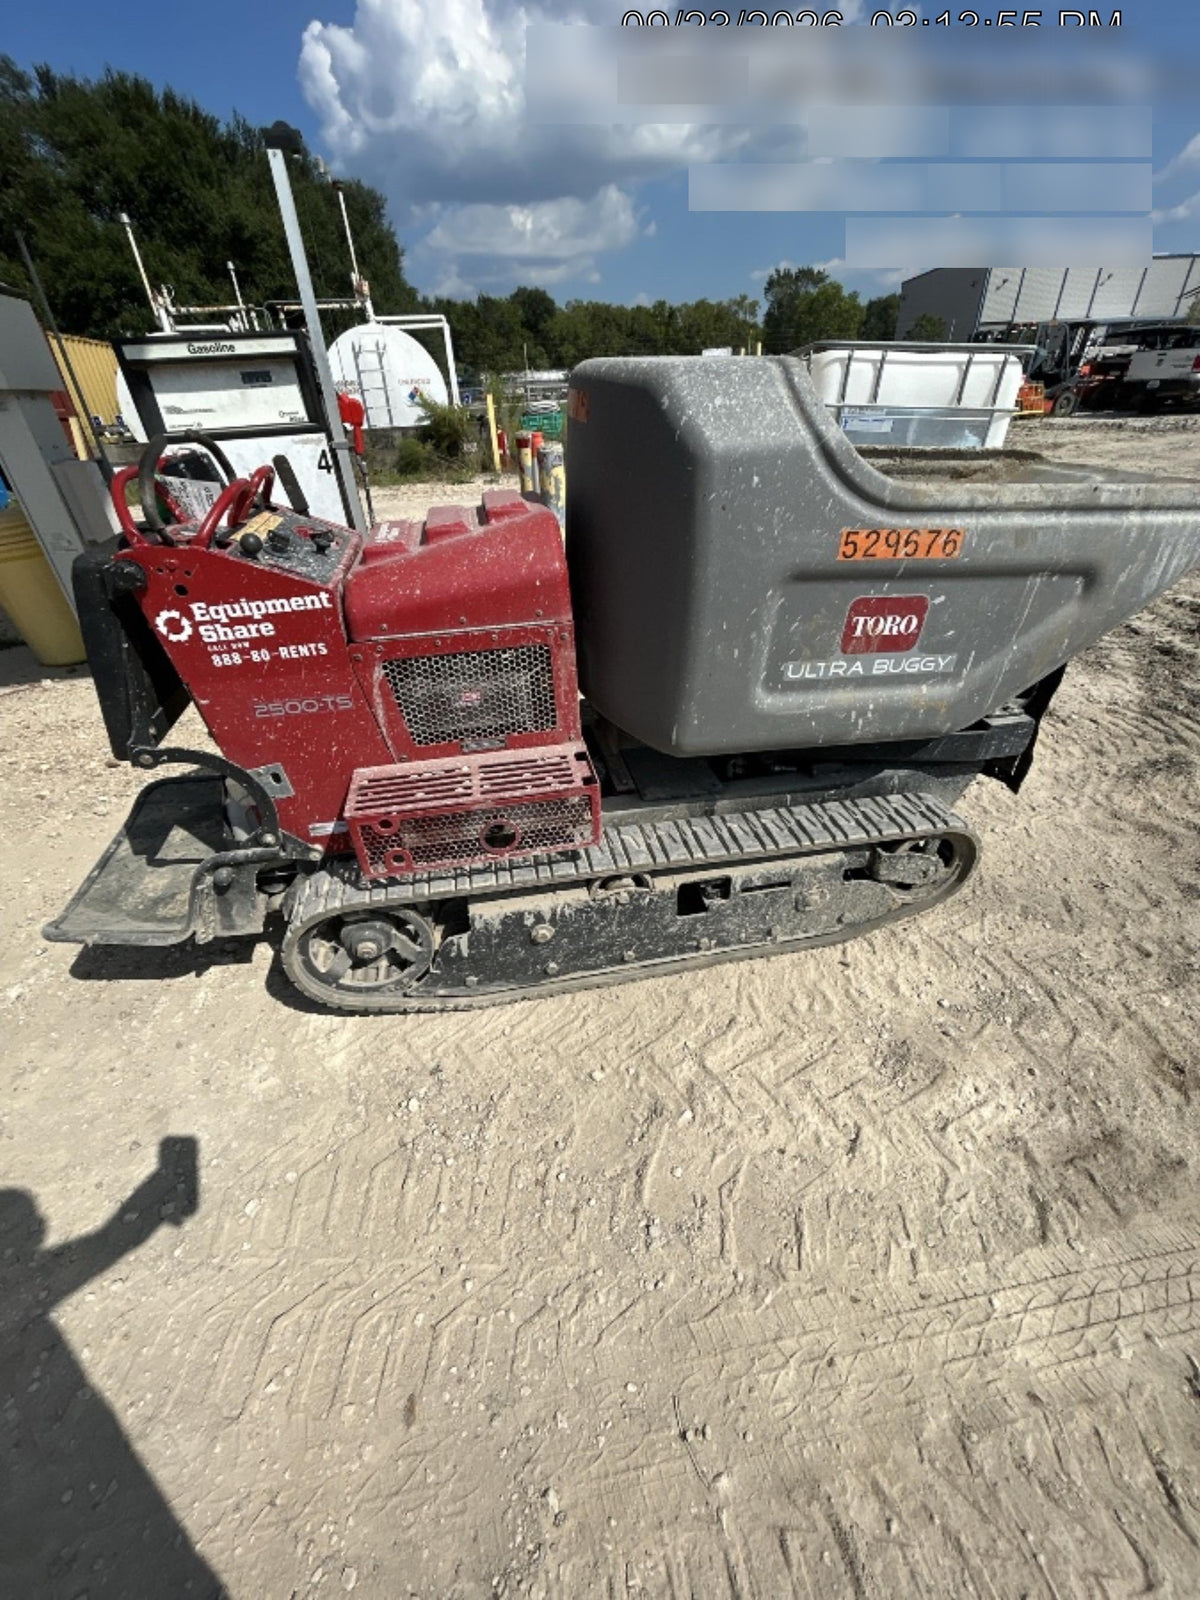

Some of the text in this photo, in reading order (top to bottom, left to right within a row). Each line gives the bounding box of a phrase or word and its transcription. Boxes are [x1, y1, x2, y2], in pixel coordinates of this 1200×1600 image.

[187, 342, 236, 355] Gasoline
[317, 449, 333, 474] 4
[841, 529, 961, 559] 529676
[189, 591, 333, 623] Equipment
[199, 621, 276, 643] Share
[851, 614, 919, 638] TORO
[786, 655, 952, 679] ULTRA BUGGY
[253, 694, 354, 718] 2500-TS
